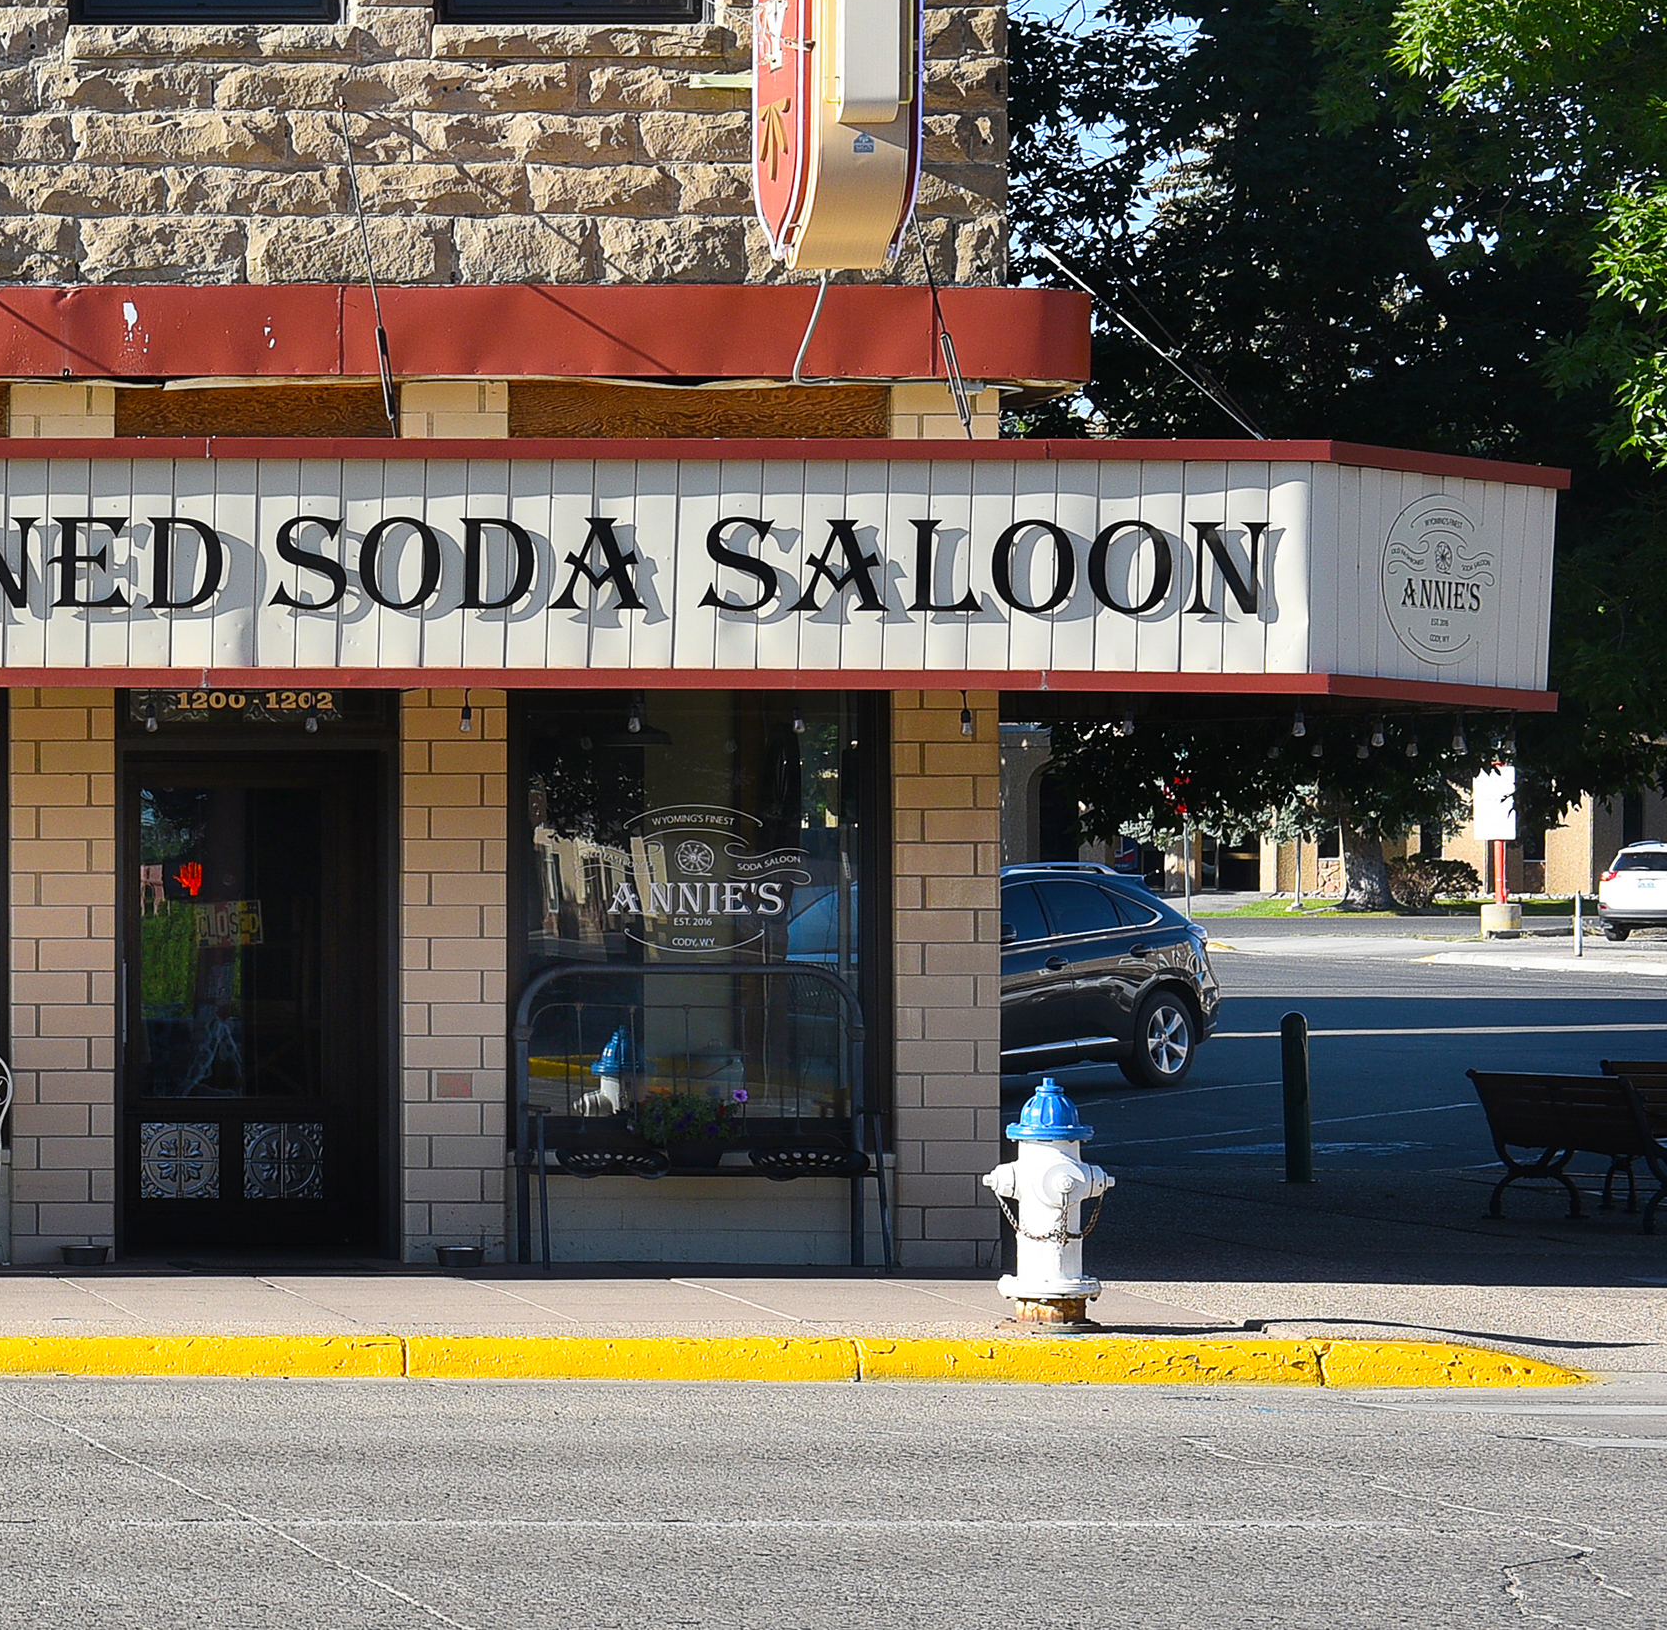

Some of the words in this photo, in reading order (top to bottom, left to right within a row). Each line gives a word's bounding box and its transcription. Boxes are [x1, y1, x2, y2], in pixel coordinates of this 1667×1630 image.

[267, 516, 646, 613] SODA
[698, 516, 1267, 616] SALOON
[1401, 578, 1481, 612] ANNIE'S
[177, 692, 246, 709] 1200
[266, 691, 333, 709] 1202
[651, 814, 703, 826] WYOMING'S
[705, 814, 735, 826] FINEST
[737, 862, 762, 872] SODA
[764, 854, 801, 868] SALOON
[606, 882, 785, 916] ANNIE'S
[673, 917, 692, 926] EST.
[693, 917, 712, 926] 2016
[671, 937, 697, 948] CODY,
[700, 937, 715, 946] WY
